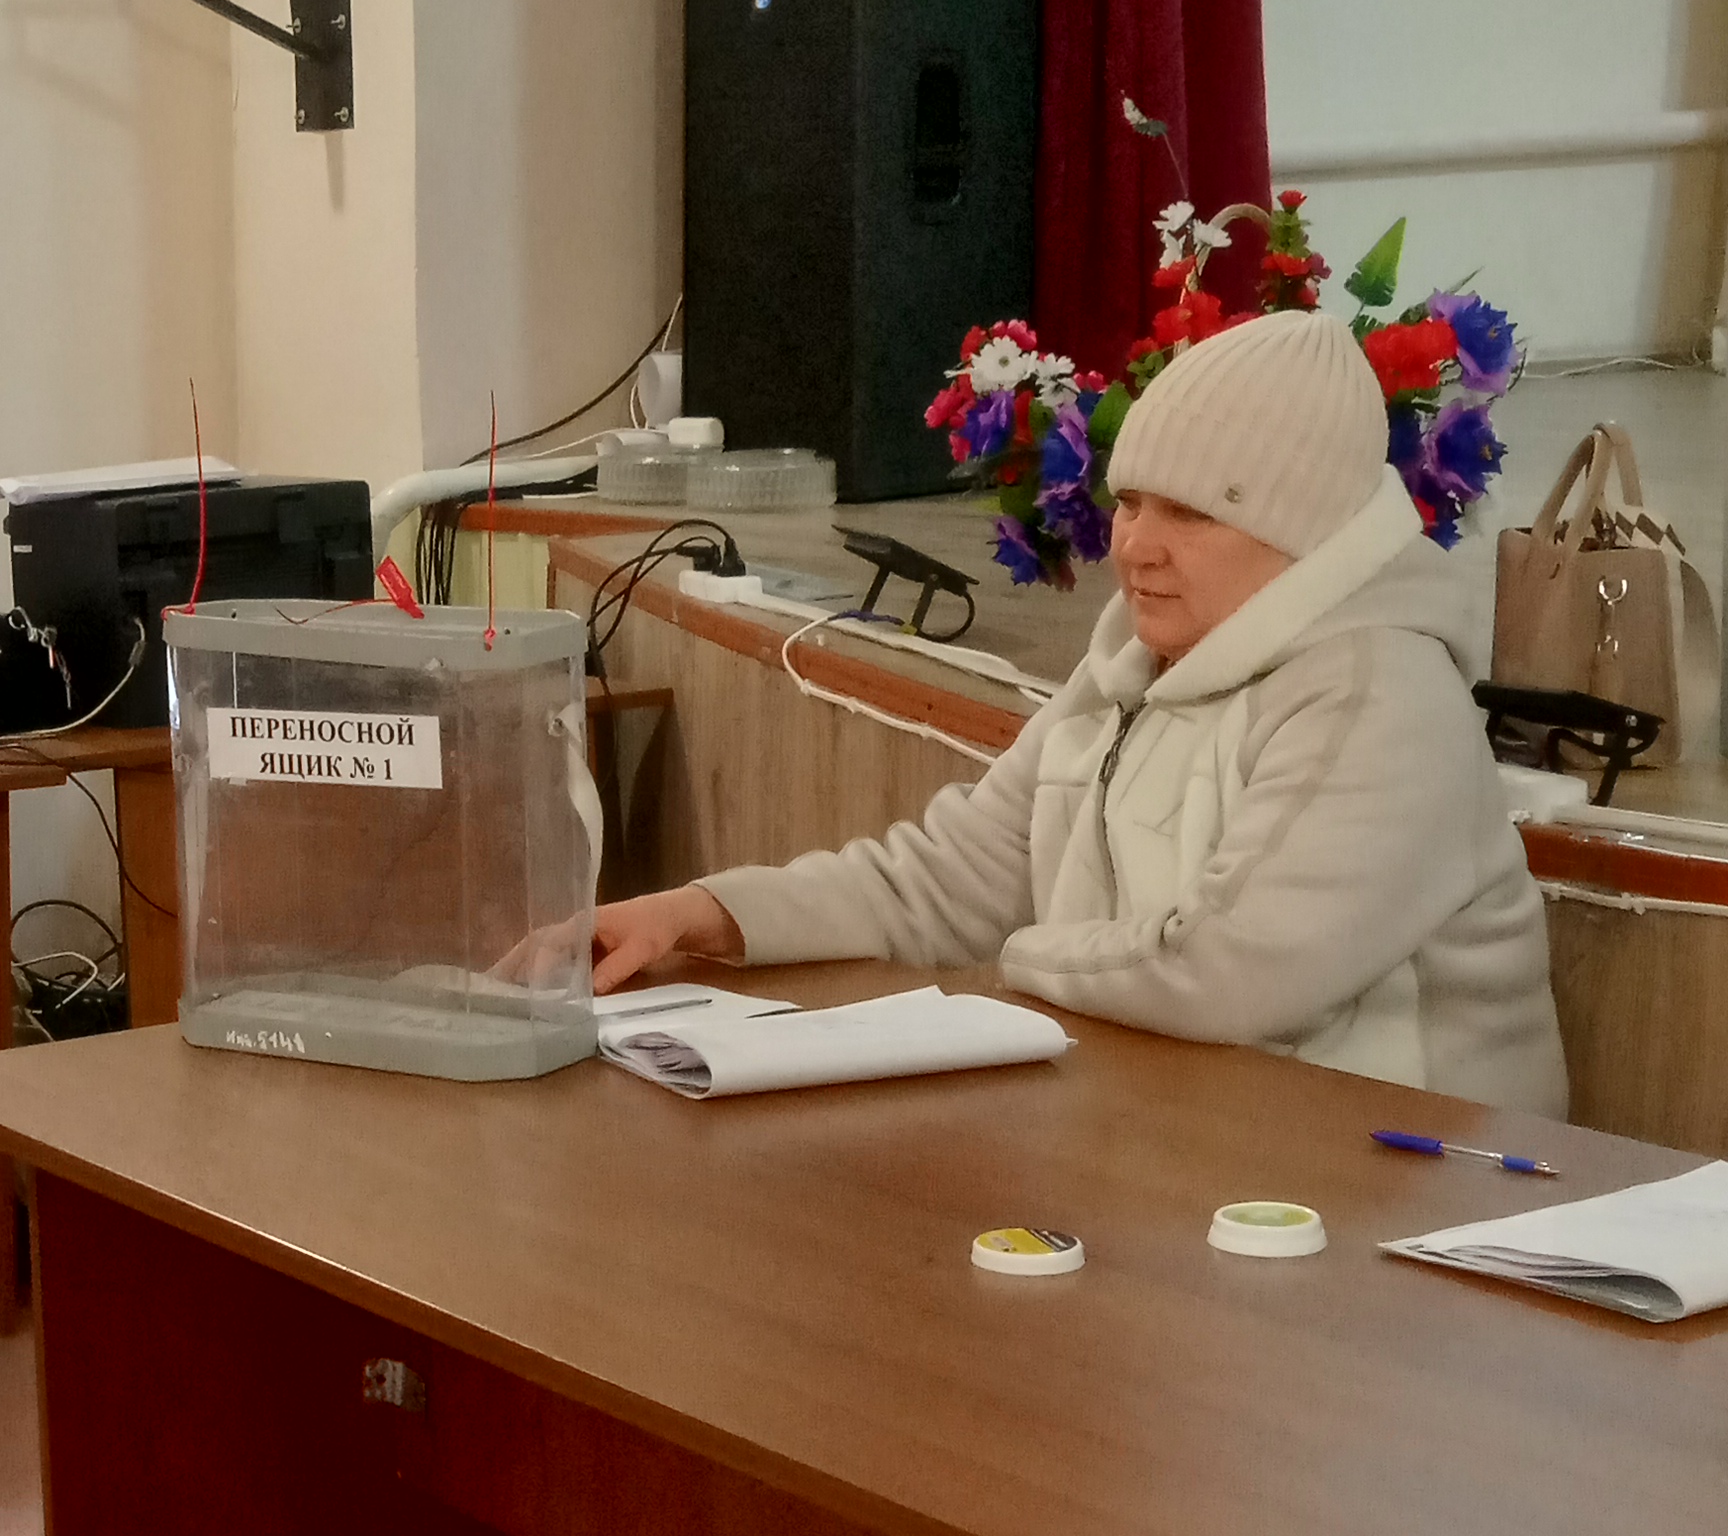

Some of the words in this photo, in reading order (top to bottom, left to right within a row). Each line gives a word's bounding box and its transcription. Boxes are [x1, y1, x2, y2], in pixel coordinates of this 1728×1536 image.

[230, 716, 415, 746] ПЕРЕНОСНОЙ
[260, 753, 342, 780] ЯЩИК
[350, 756, 375, 779] №
[384, 758, 393, 780] 1
